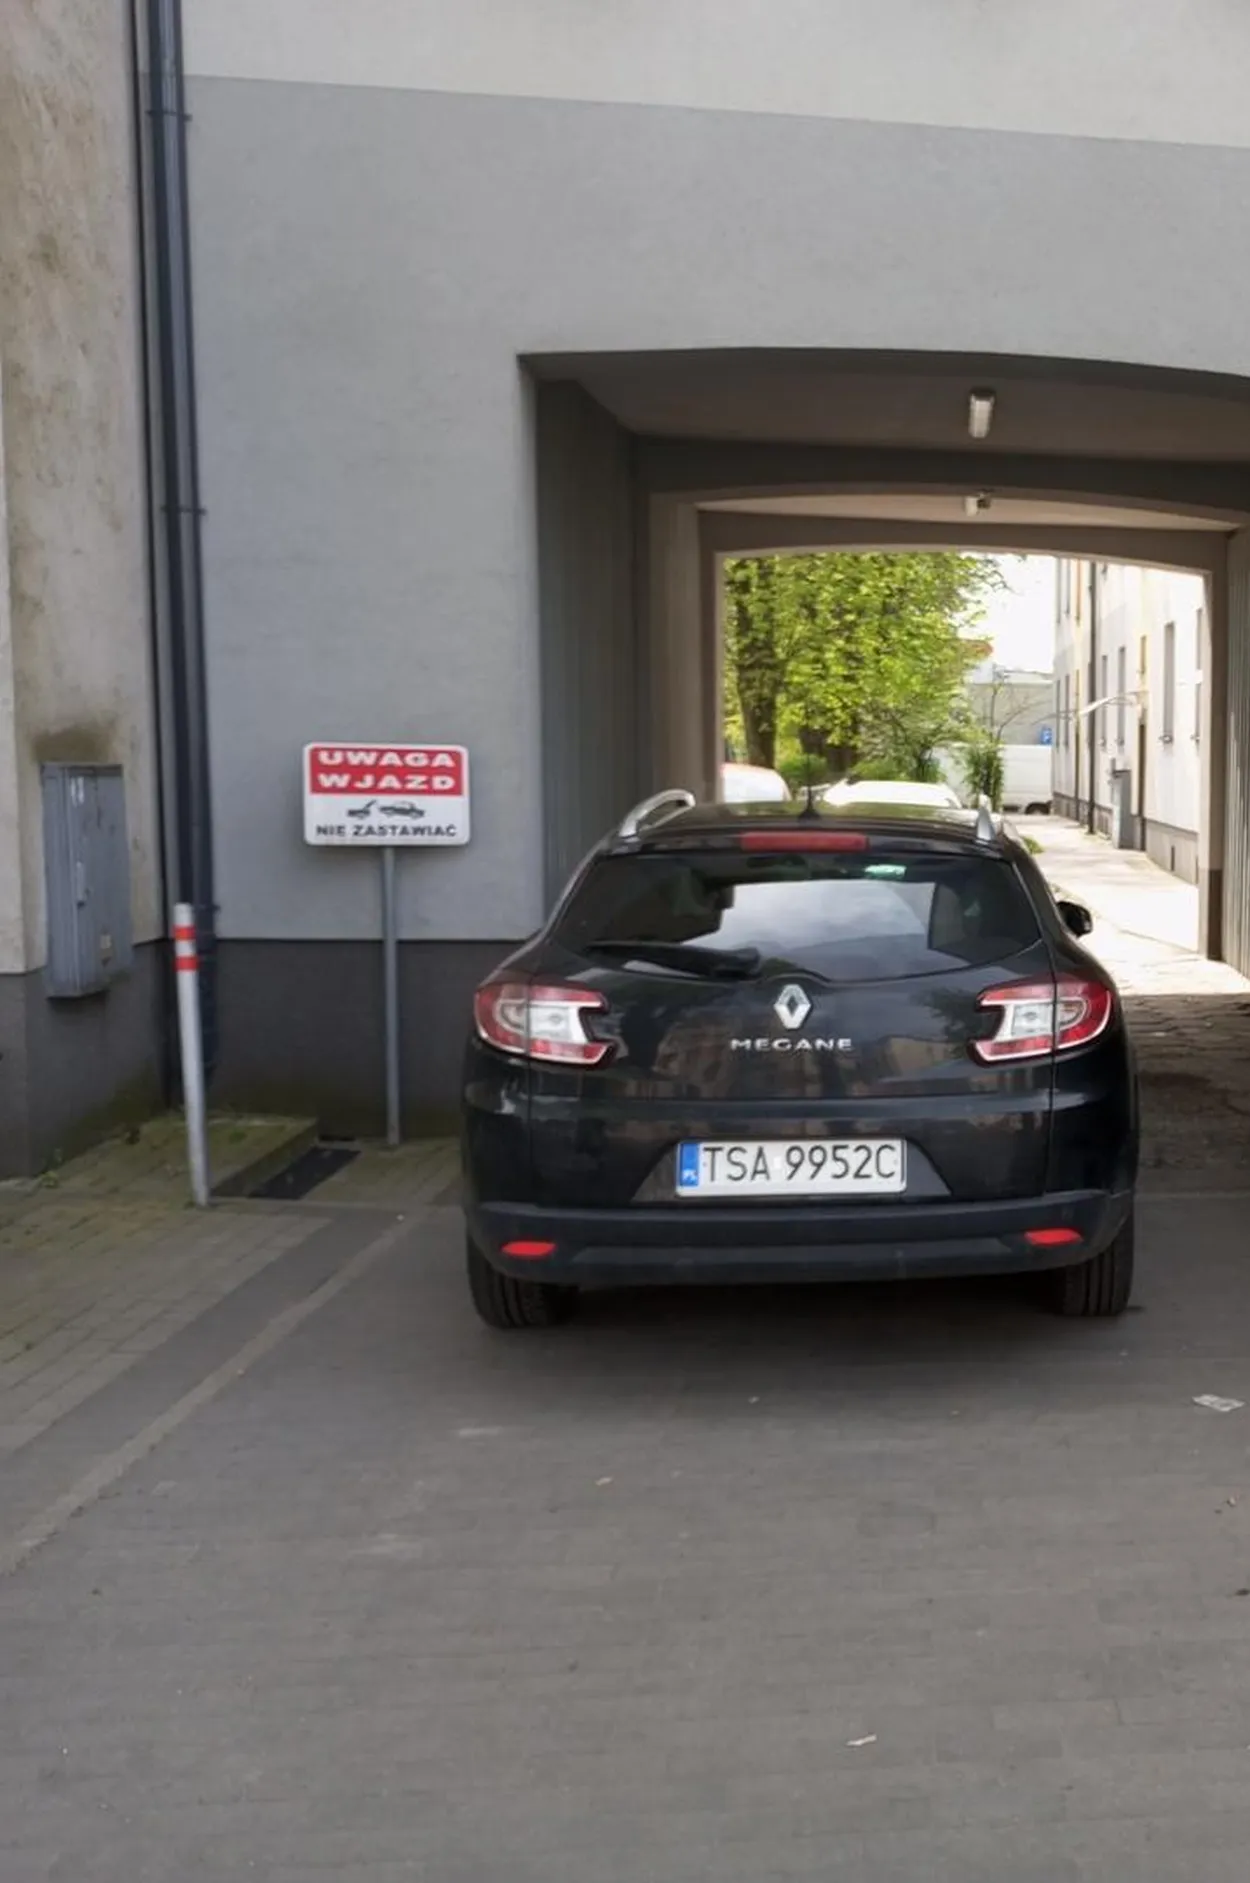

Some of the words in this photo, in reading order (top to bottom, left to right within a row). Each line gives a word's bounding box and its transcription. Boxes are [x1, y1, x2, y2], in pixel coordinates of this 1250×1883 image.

[318, 750, 454, 767] UWAGA
[318, 773, 455, 790] WJAZD
[316, 825, 346, 837] NIE
[730, 1038, 853, 1051] MEGANE
[703, 1145, 772, 1183] TSA
[784, 1143, 897, 1181] 9952C
